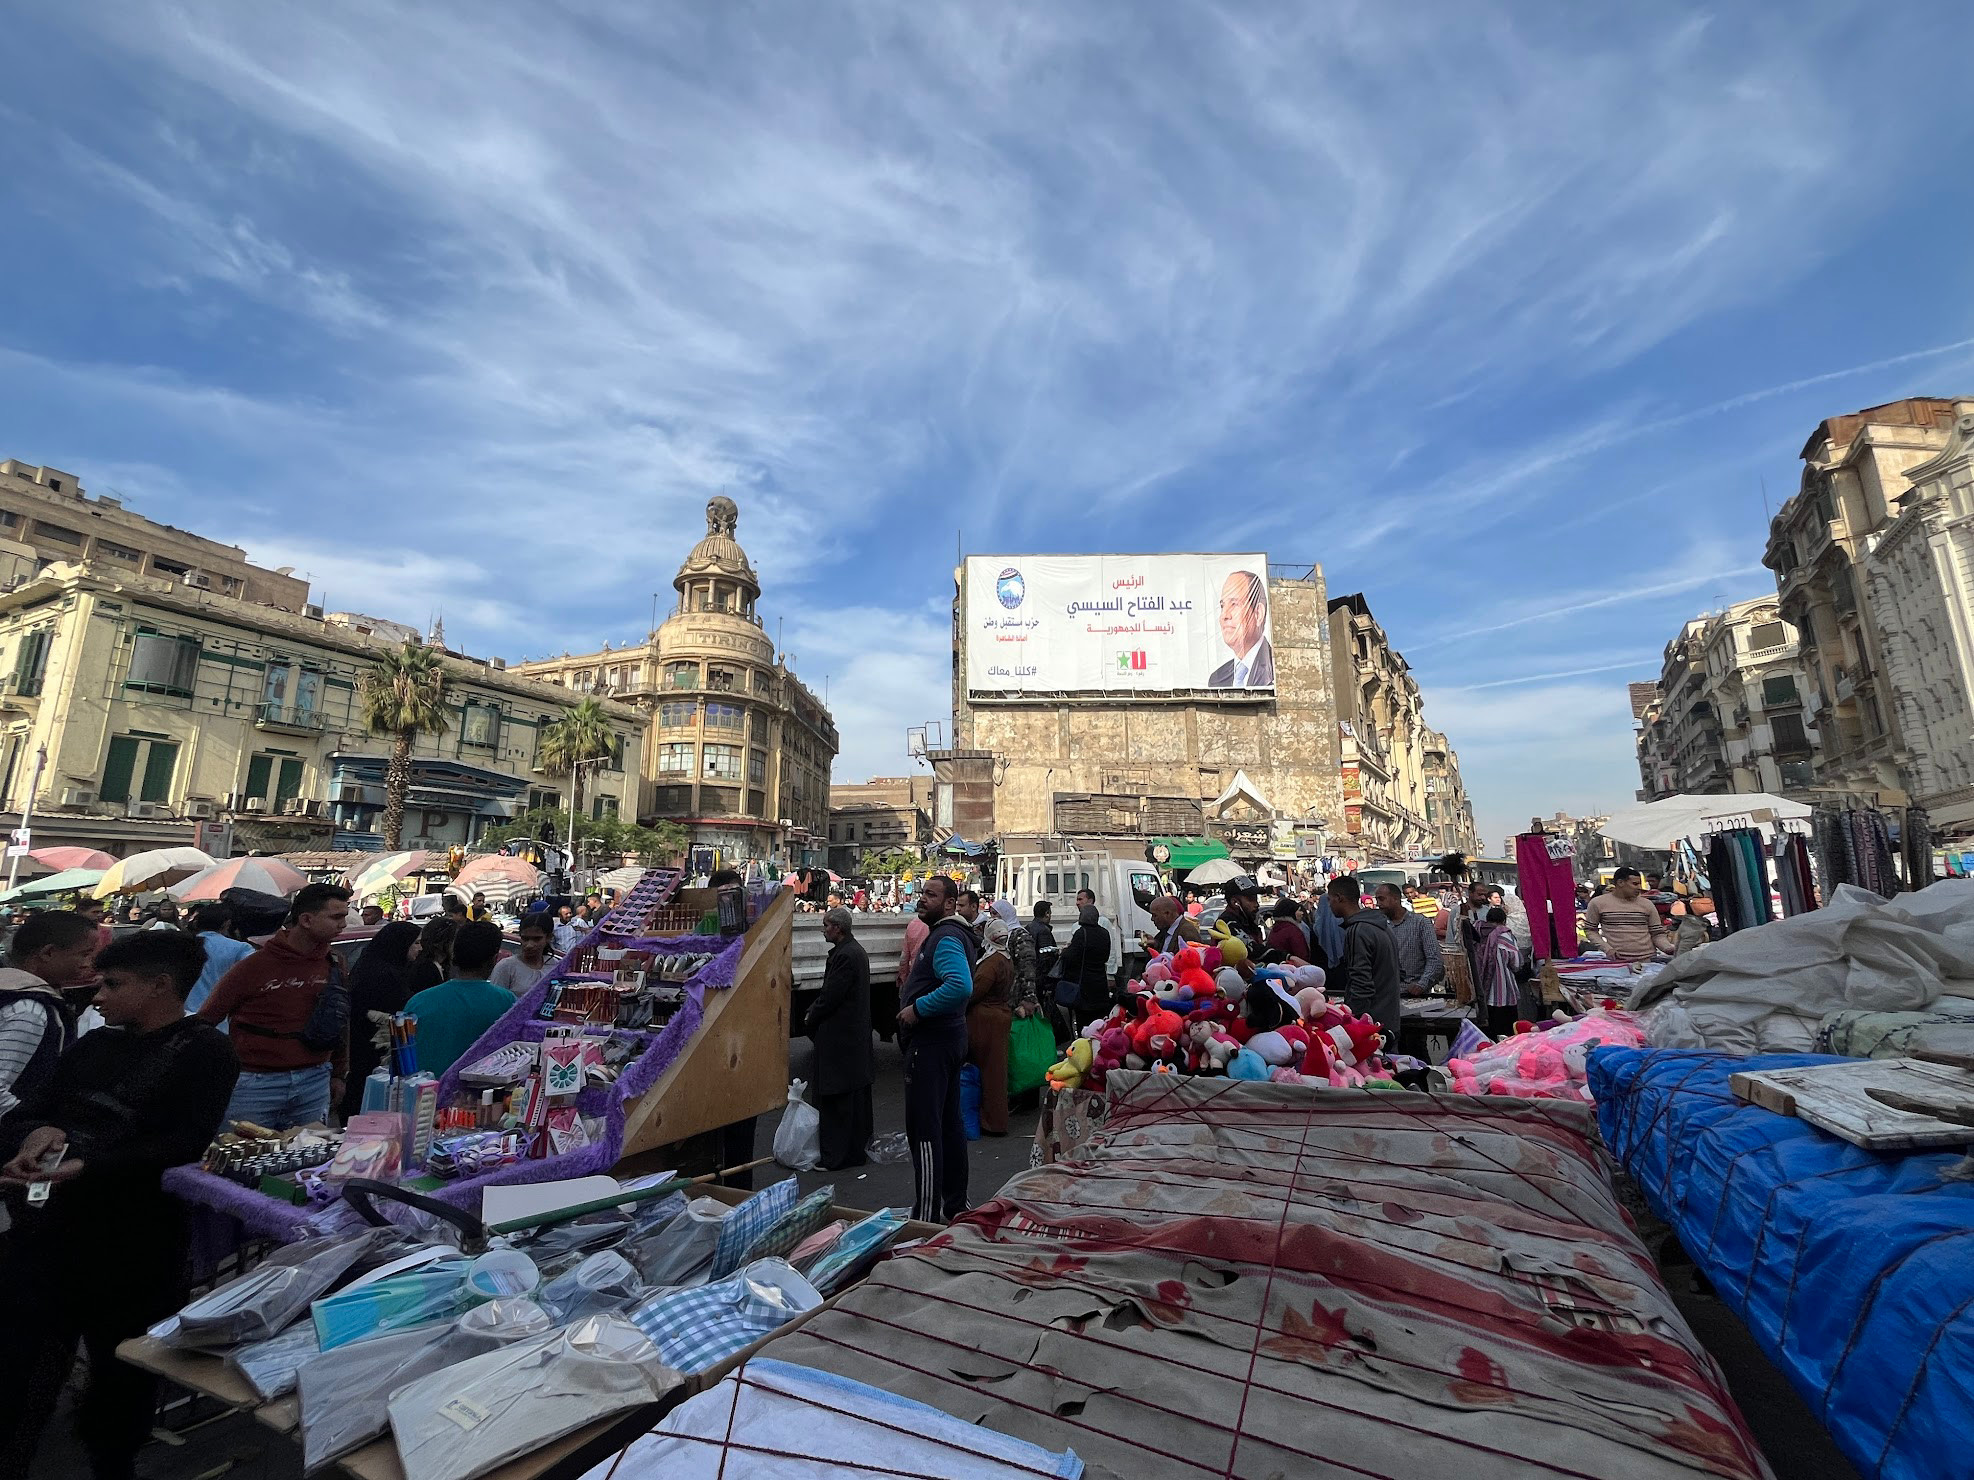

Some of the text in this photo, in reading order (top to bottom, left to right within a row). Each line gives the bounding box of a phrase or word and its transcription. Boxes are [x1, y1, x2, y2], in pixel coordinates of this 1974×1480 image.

[1112, 574, 1144, 590] الرئيس
[1066, 596, 1193, 619] عبد الفتاح السيسي
[983, 616, 1040, 630] حزب مستقبل وطن
[1086, 622, 1141, 635] للجمهورية
[699, 634, 758, 652] TIRING
[987, 665, 1037, 677] #كلنا_معاك
